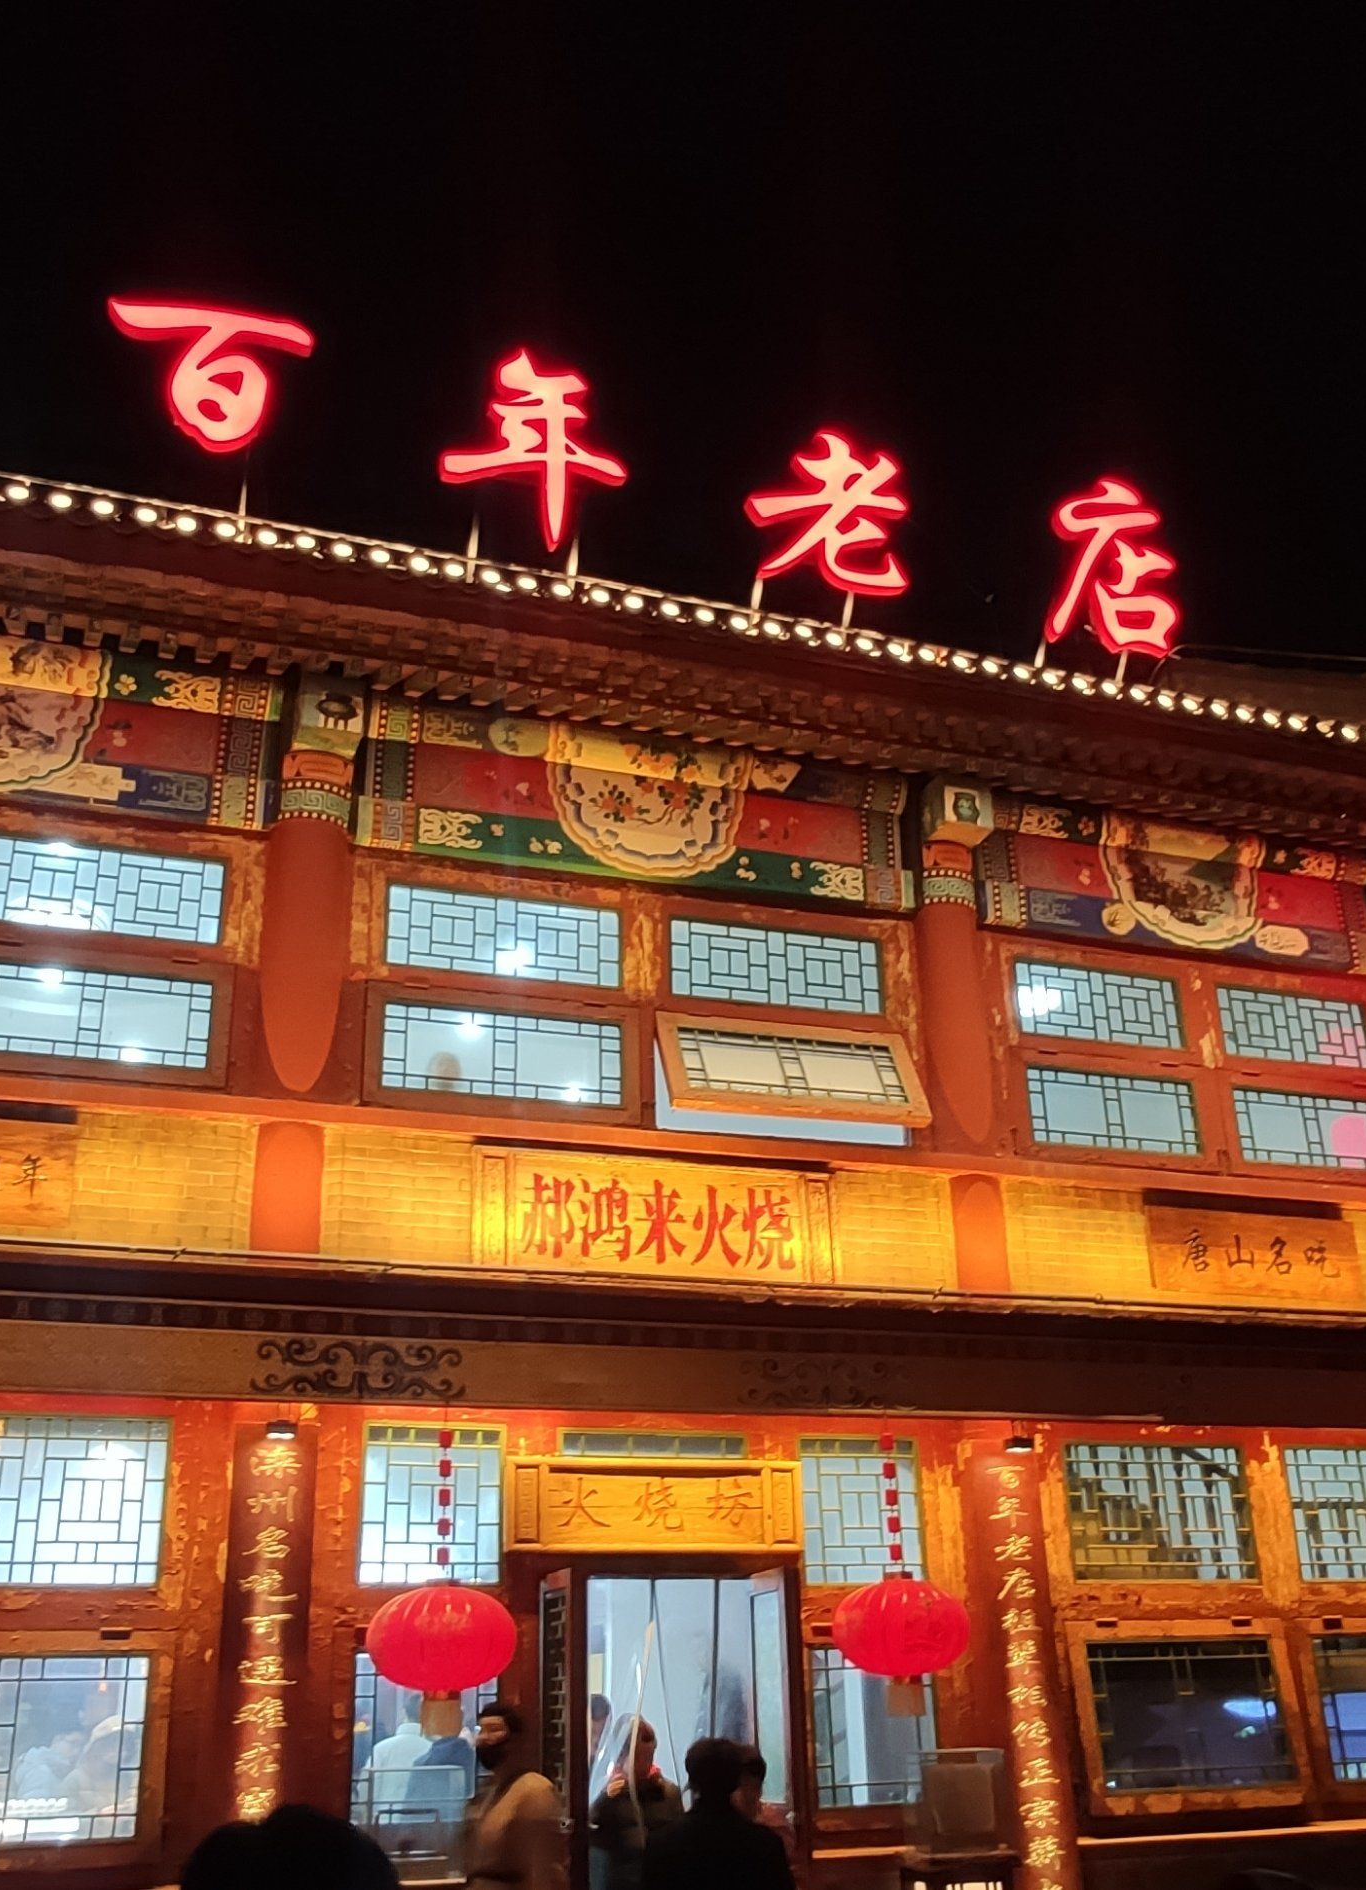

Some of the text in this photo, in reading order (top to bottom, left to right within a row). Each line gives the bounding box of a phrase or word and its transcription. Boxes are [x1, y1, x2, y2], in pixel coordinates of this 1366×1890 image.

[108, 296, 1181, 658] 百年老店
[519, 1172, 796, 1271] 郝鸿来火烧
[557, 1476, 754, 1532] 火烧坊
